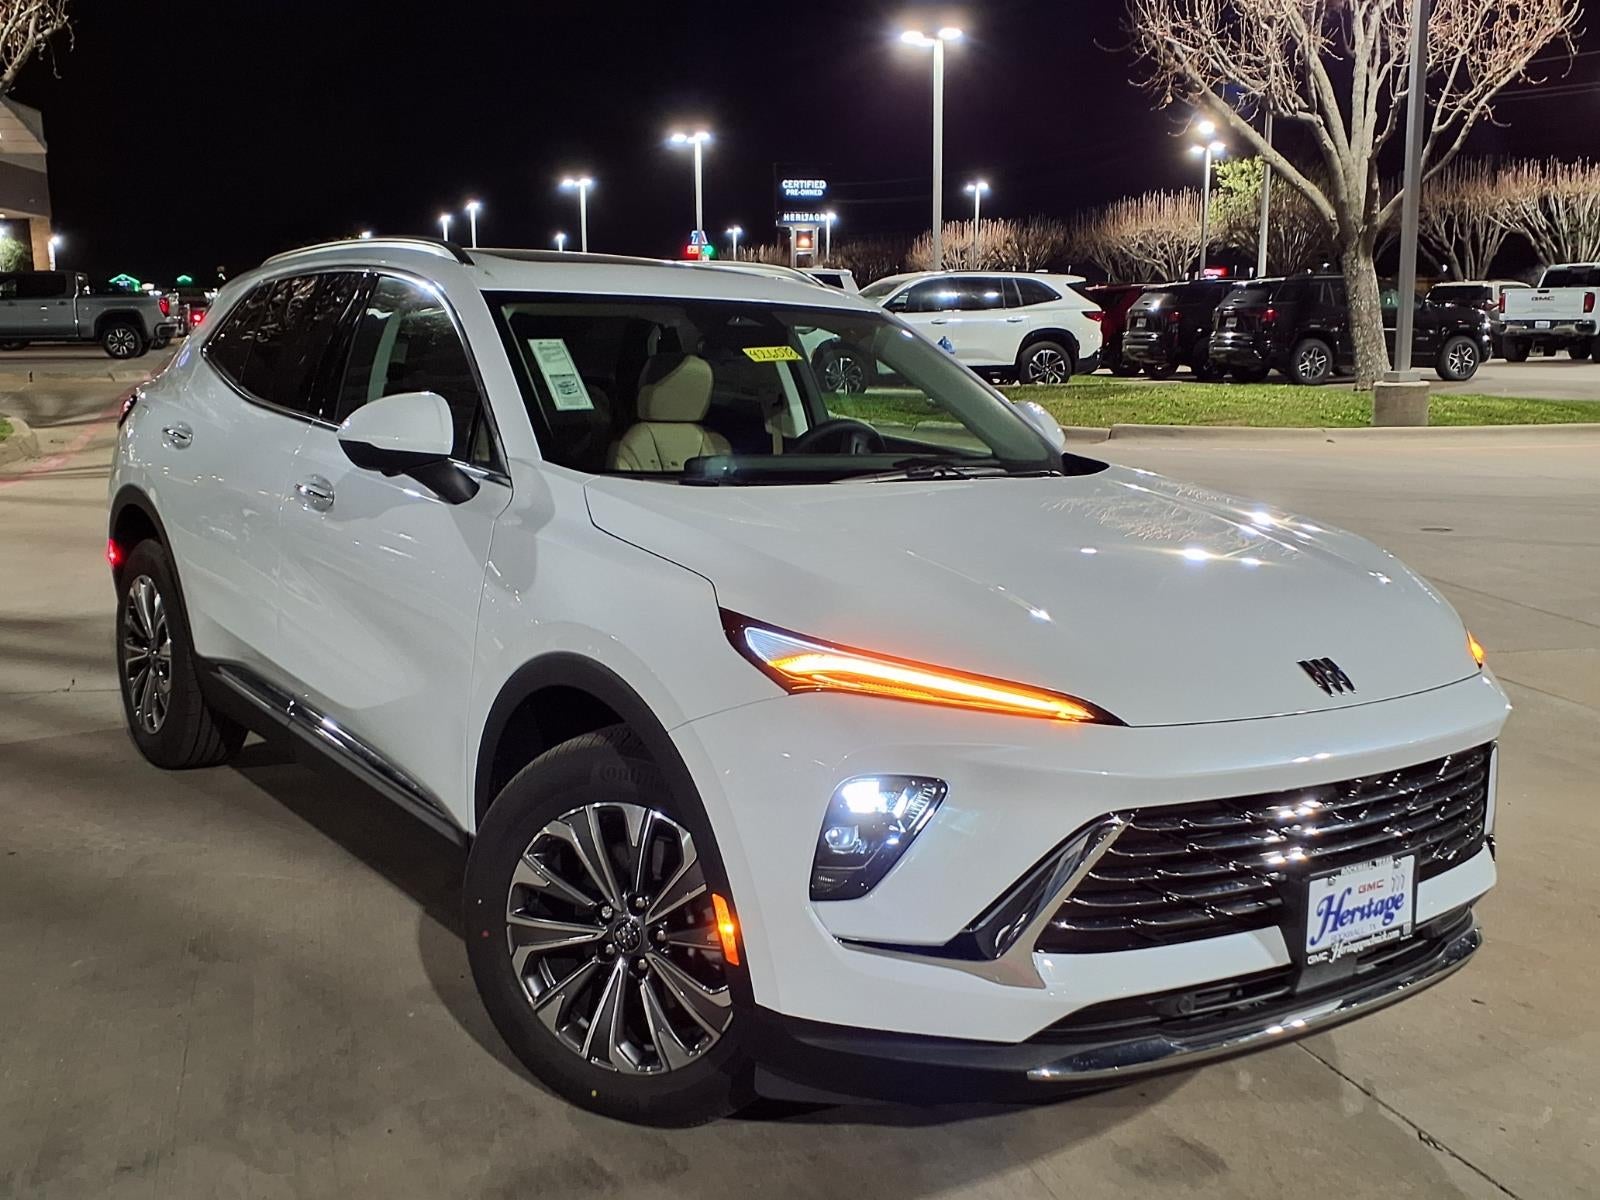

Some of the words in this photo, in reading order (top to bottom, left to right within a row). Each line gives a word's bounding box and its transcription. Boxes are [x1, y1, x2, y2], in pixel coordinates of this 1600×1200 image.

[782, 180, 826, 188] CERTIFIED
[1358, 880, 1384, 894] GMC
[1309, 887, 1405, 946] Heritage
[1308, 952, 1329, 965] GMC
